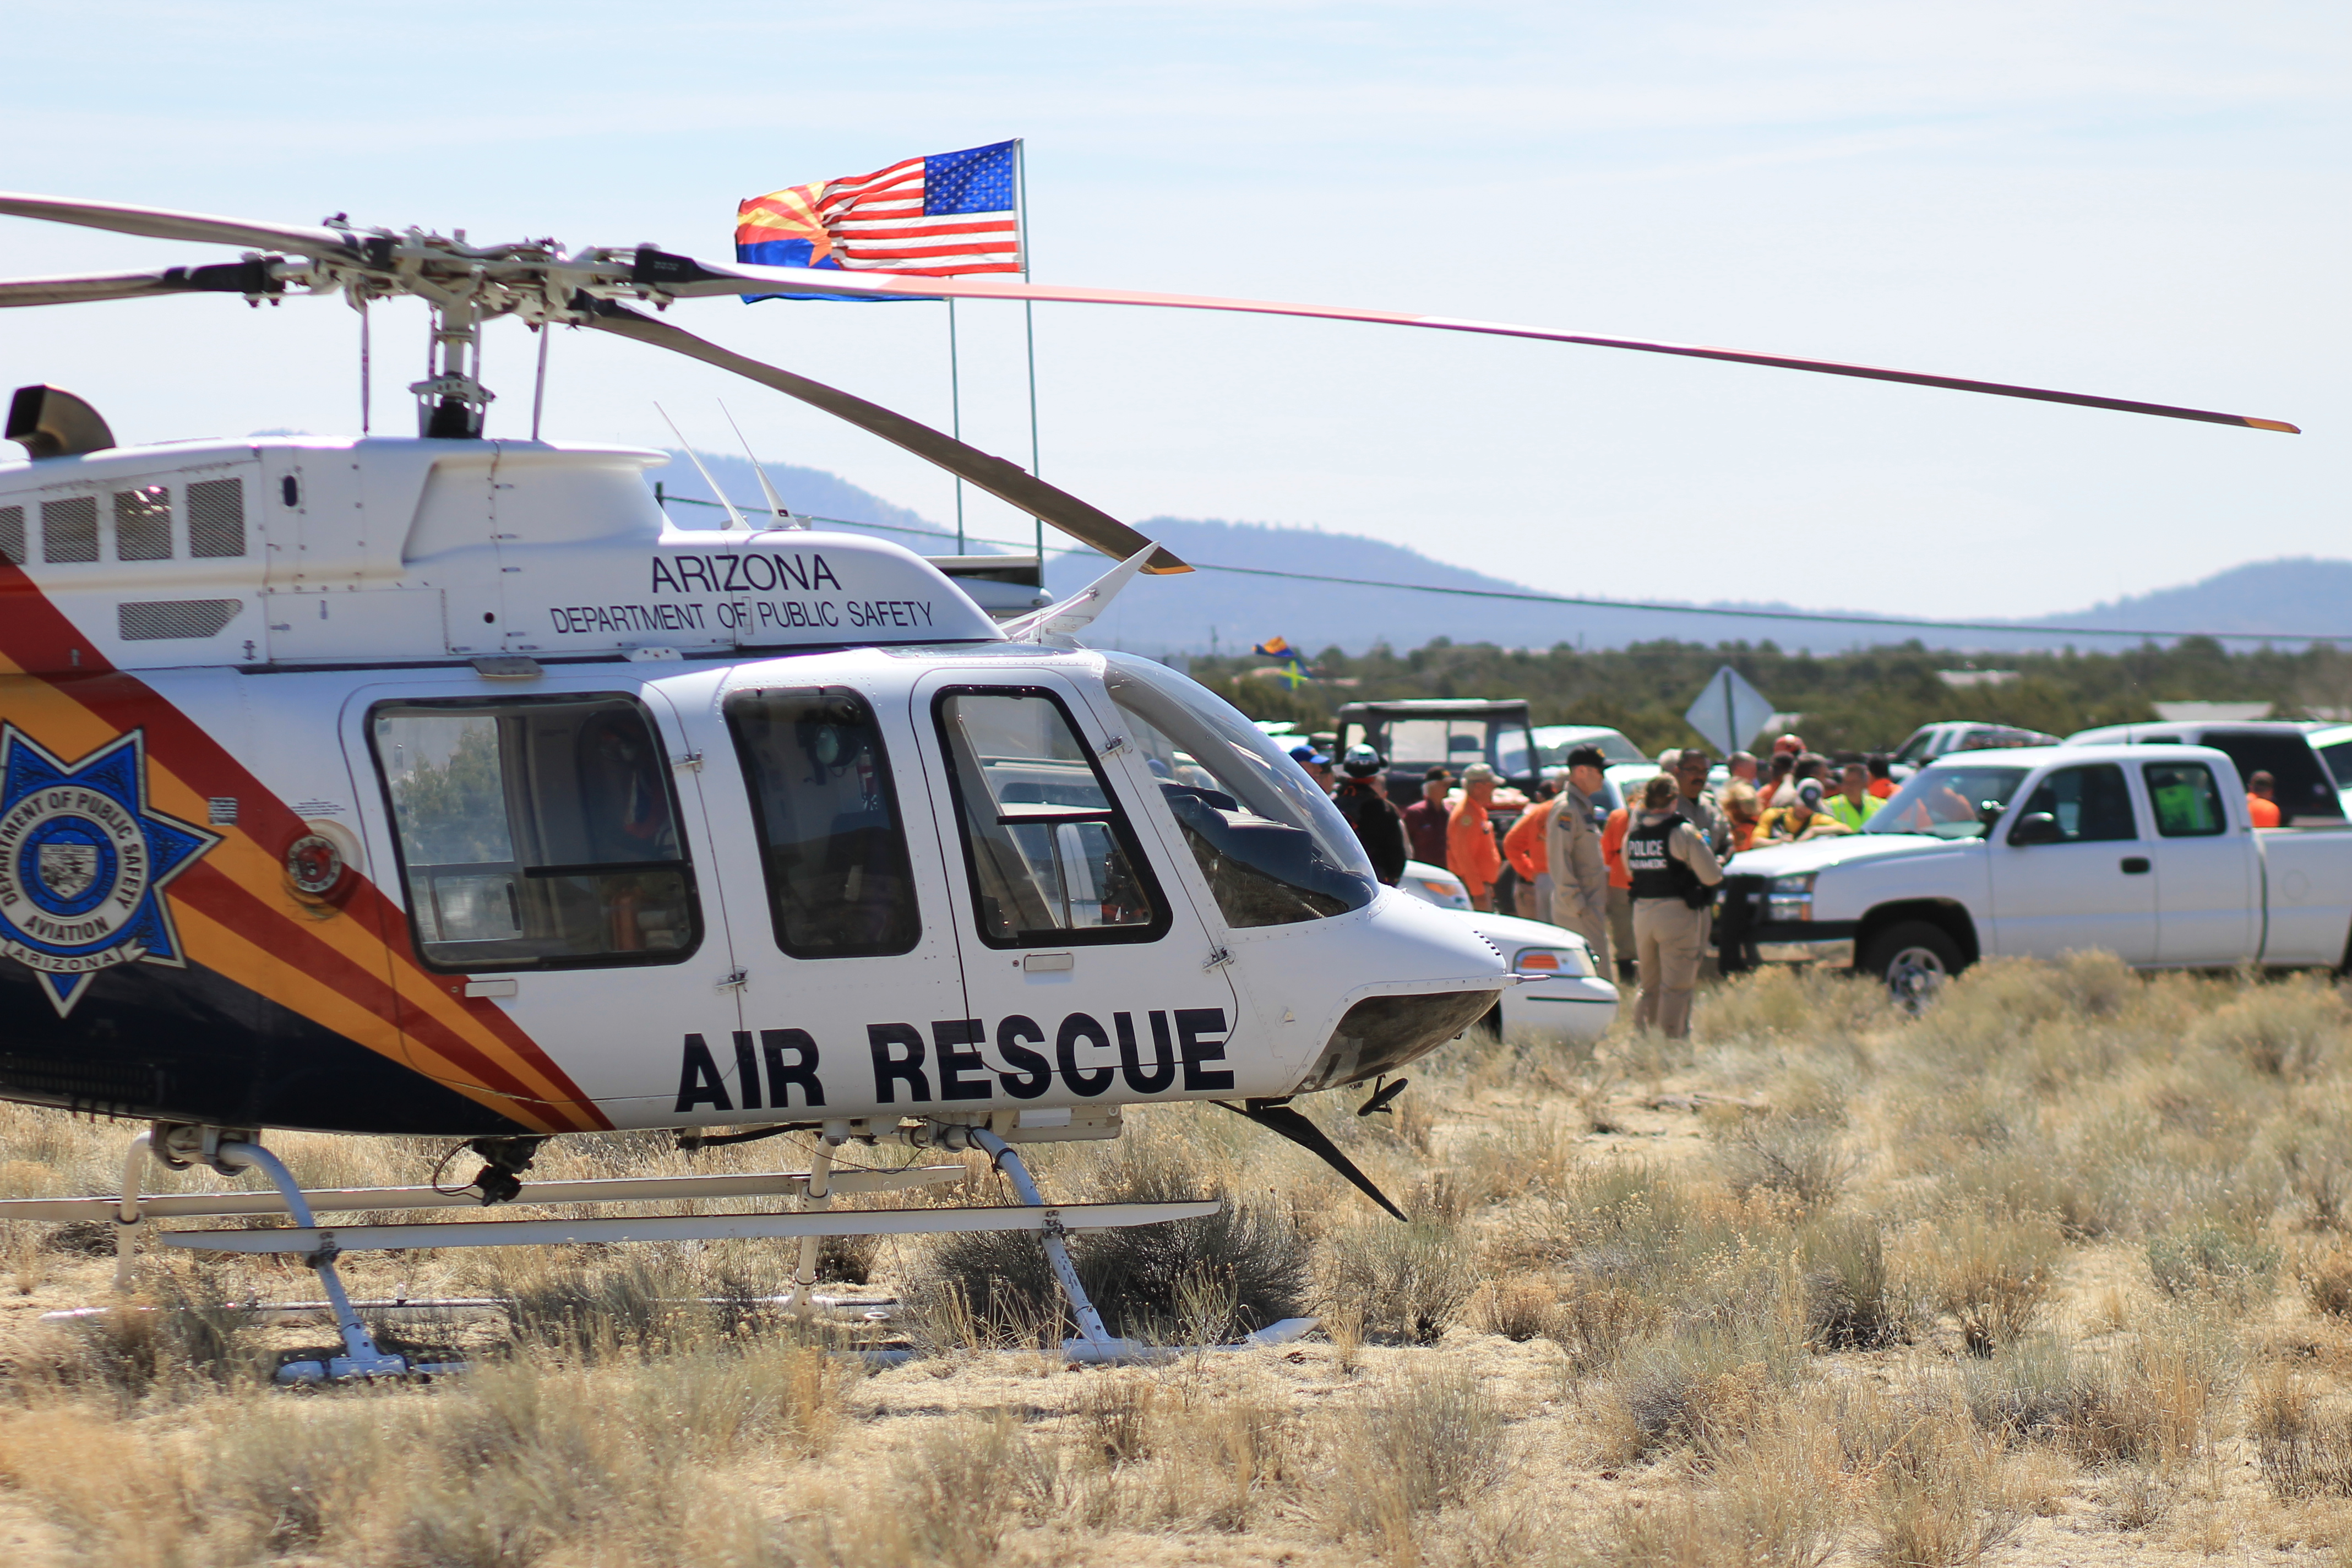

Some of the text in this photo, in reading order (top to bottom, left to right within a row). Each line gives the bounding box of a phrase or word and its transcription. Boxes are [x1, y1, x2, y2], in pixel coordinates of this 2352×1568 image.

[652, 553, 842, 594] ARIZONA
[549, 601, 934, 634] DEPARTMENT OF PUBLIC SAFETY
[48, 791, 72, 809] OF
[77, 792, 133, 840] PUBLIC
[115, 843, 142, 910] SAFETY
[1628, 840, 1664, 856] POLICE
[24, 914, 109, 941] AVIATION
[13, 948, 115, 971] ARIZONA
[674, 1008, 1235, 1113] AIR RESCUE
